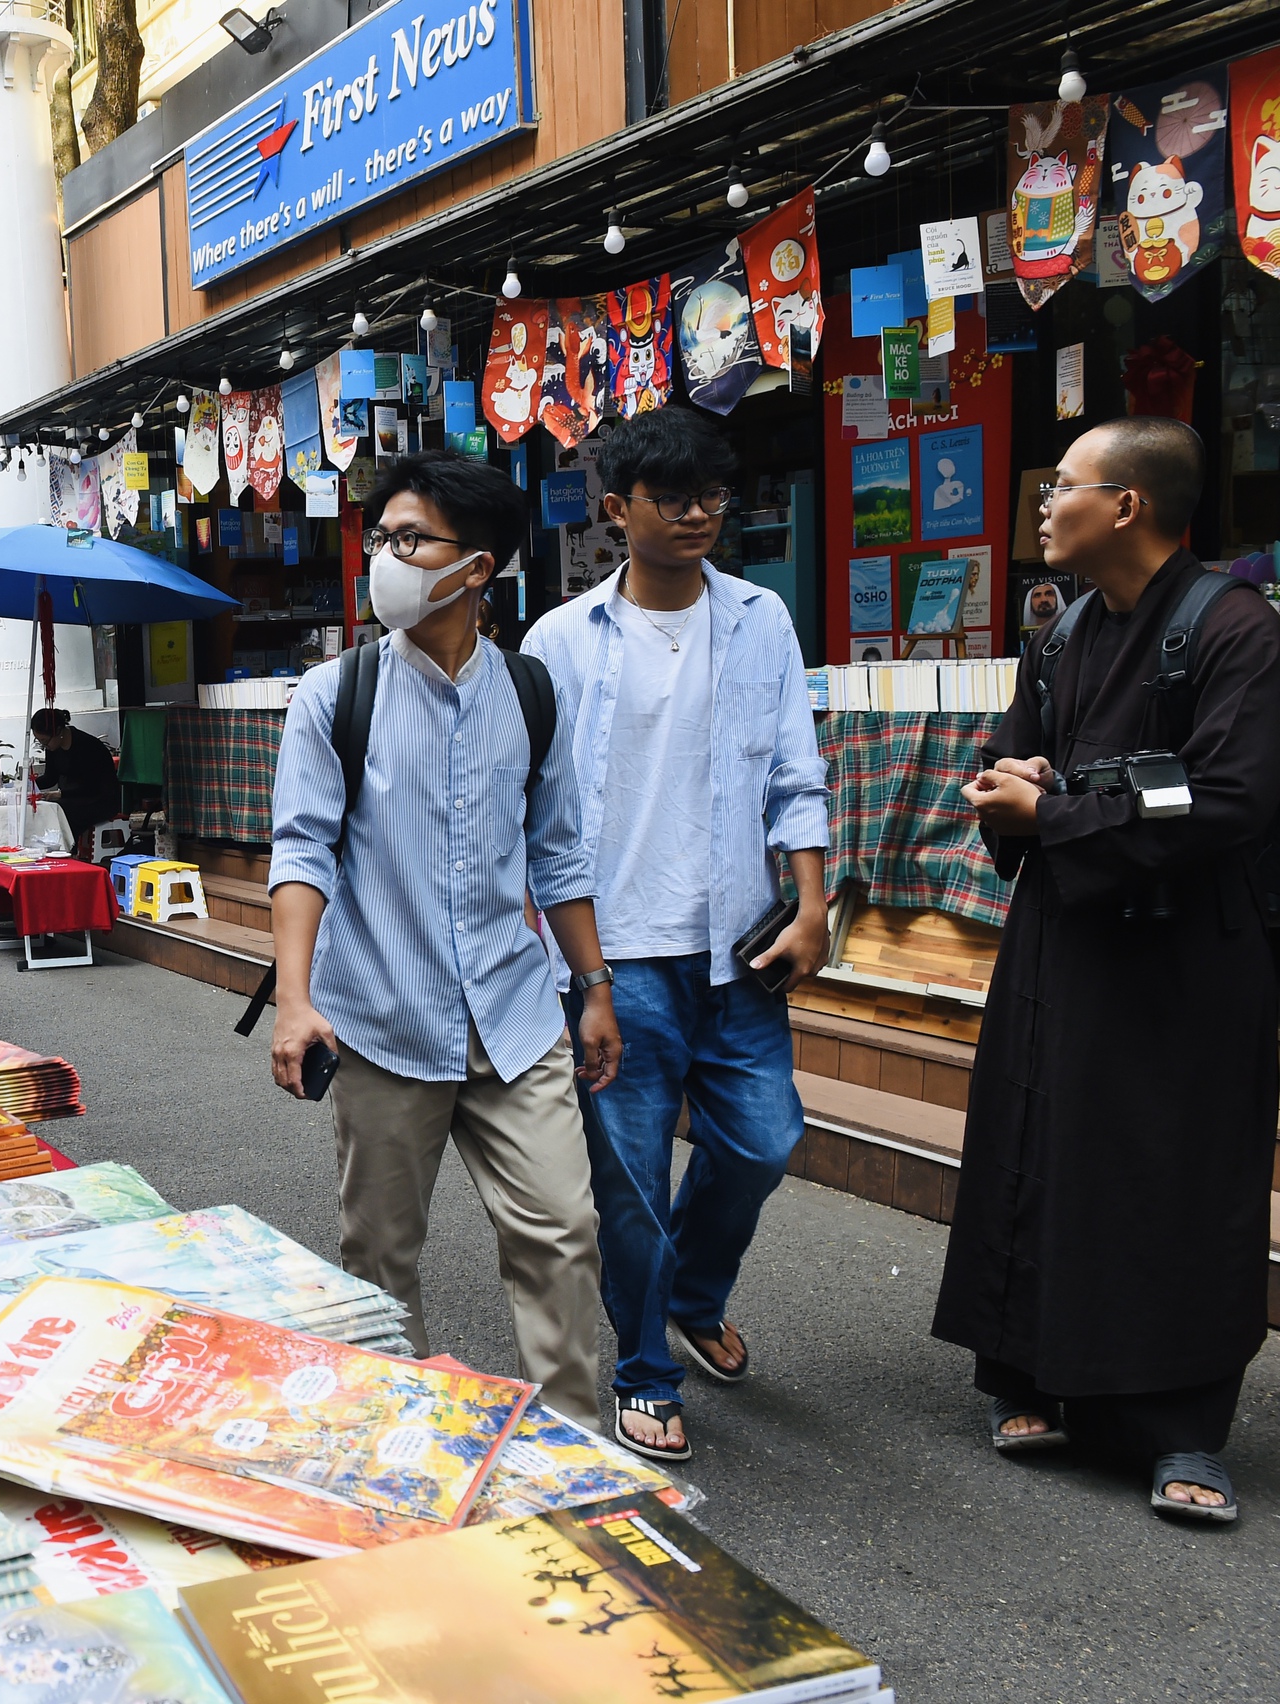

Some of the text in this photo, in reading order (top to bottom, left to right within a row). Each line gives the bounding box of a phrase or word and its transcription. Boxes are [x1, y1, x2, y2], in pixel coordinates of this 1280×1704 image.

[300, 0, 498, 154] First News
[192, 234, 236, 275] Where
[240, 201, 291, 251] there's
[296, 199, 307, 221] a
[311, 168, 343, 212] will
[364, 125, 432, 184] there's
[439, 117, 453, 144] a
[460, 87, 512, 134] way
[927, 241, 939, 249] của
[888, 412, 918, 431] ÁCH
[949, 436, 970, 447] Lewis
[866, 450, 883, 462] HOA
[951, 517, 962, 526] Con
[941, 568, 960, 576] DUY
[1022, 575, 1070, 585] MY VISION
[854, 590, 888, 604] OSHO
[602, 1518, 646, 1544] LAI
[626, 1540, 673, 1567] GIA
